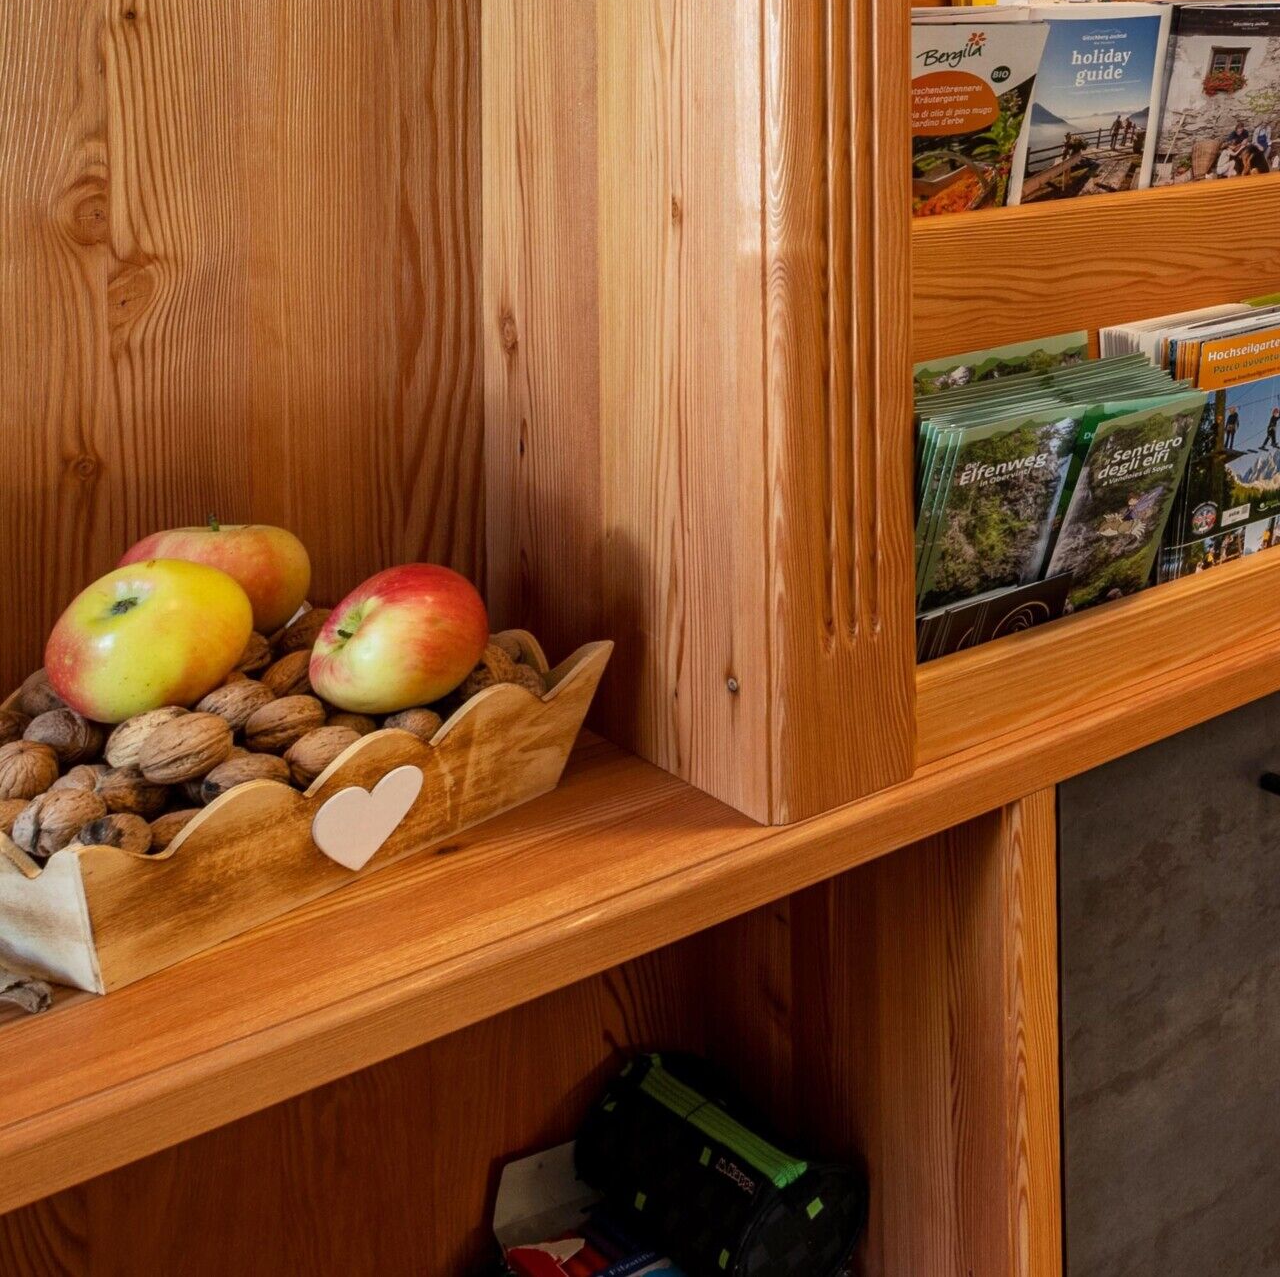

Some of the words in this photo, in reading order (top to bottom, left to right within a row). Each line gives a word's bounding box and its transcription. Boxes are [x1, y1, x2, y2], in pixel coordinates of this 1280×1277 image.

[916, 42, 982, 69] Bergila
[1071, 48, 1132, 67] holiday
[991, 70, 1009, 79] BIO
[1075, 64, 1123, 87] guide
[914, 94, 969, 105] Kräutergarten
[954, 108, 971, 117] pino
[971, 106, 993, 116] mugo
[1213, 362, 1240, 374] Parco
[1111, 436, 1183, 464] Sentiero
[959, 452, 1049, 486] Elfenweg
[1097, 455, 1141, 479] degli
[1142, 448, 1170, 467] elfi
[979, 479, 988, 487] in
[1109, 471, 1143, 485] Vandoies
[1151, 463, 1174, 473] Sopra
